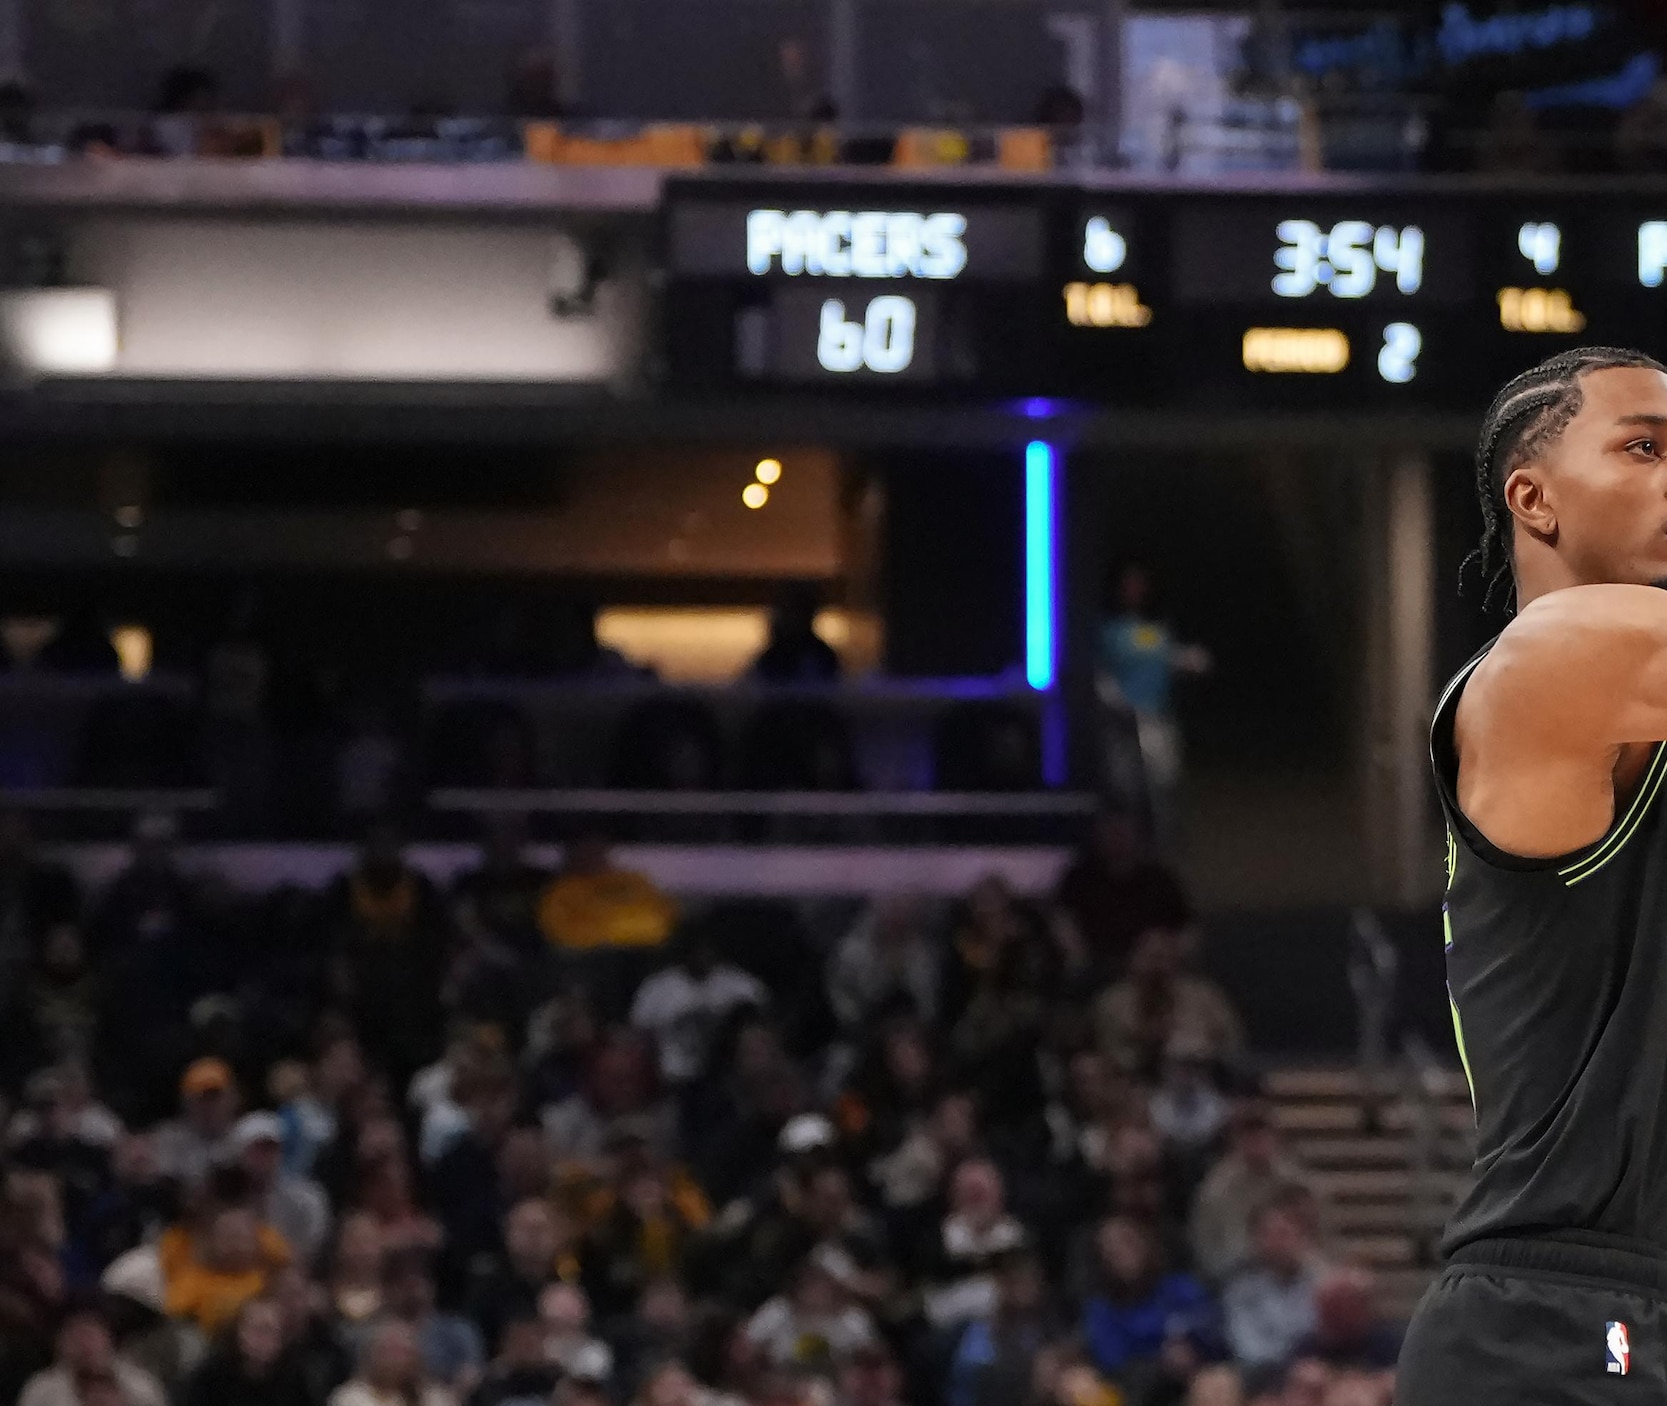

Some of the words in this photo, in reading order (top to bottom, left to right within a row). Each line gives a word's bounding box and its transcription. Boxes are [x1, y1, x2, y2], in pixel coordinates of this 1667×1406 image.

[747, 209, 968, 280] PACERS
[1084, 215, 1127, 273] 6
[1271, 219, 1425, 299] 3:54
[817, 294, 917, 373] 60
[1377, 322, 1422, 383] 2
